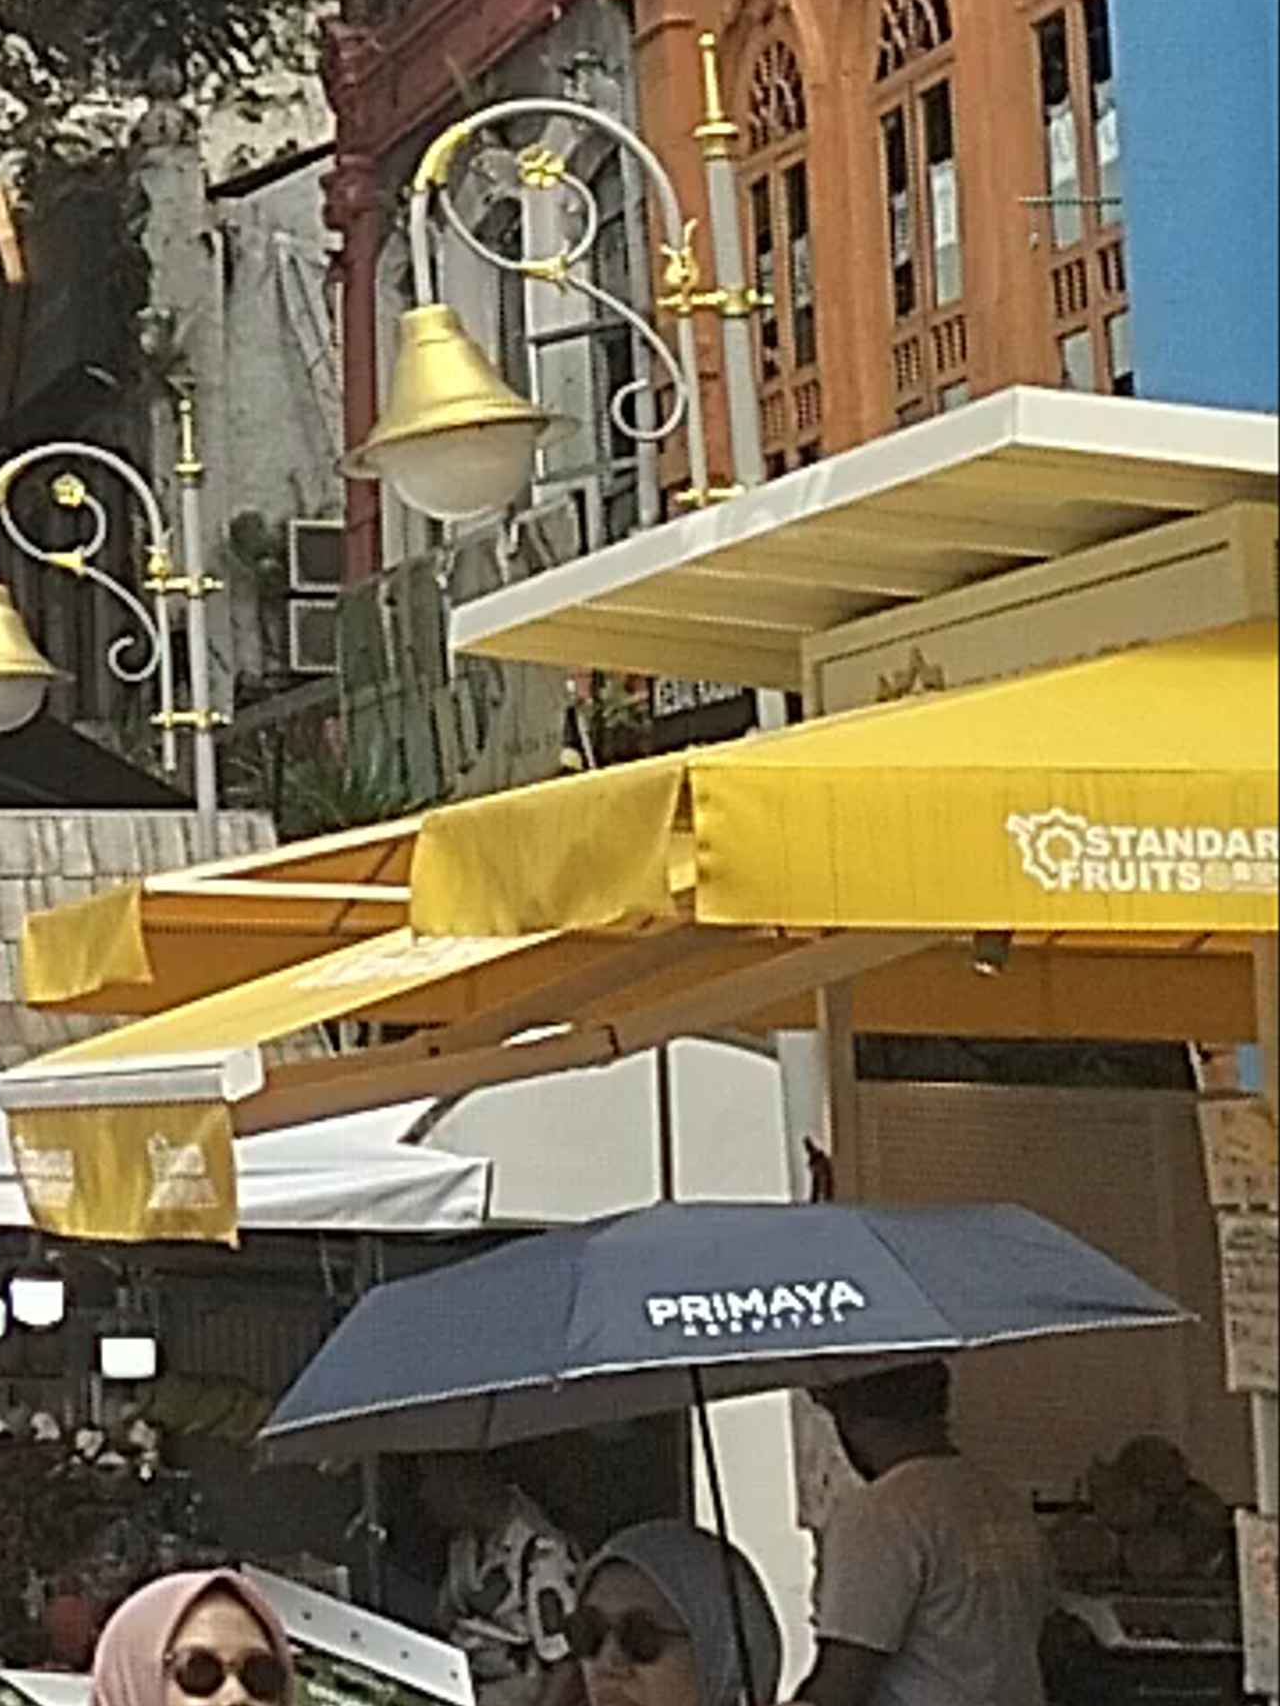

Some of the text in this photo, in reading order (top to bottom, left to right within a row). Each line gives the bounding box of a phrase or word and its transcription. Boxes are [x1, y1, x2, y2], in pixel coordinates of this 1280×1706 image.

[1085, 826, 1278, 857] STANDAR
[1060, 859, 1202, 891] FRUITS
[647, 1282, 865, 1326] PRIMAYA
